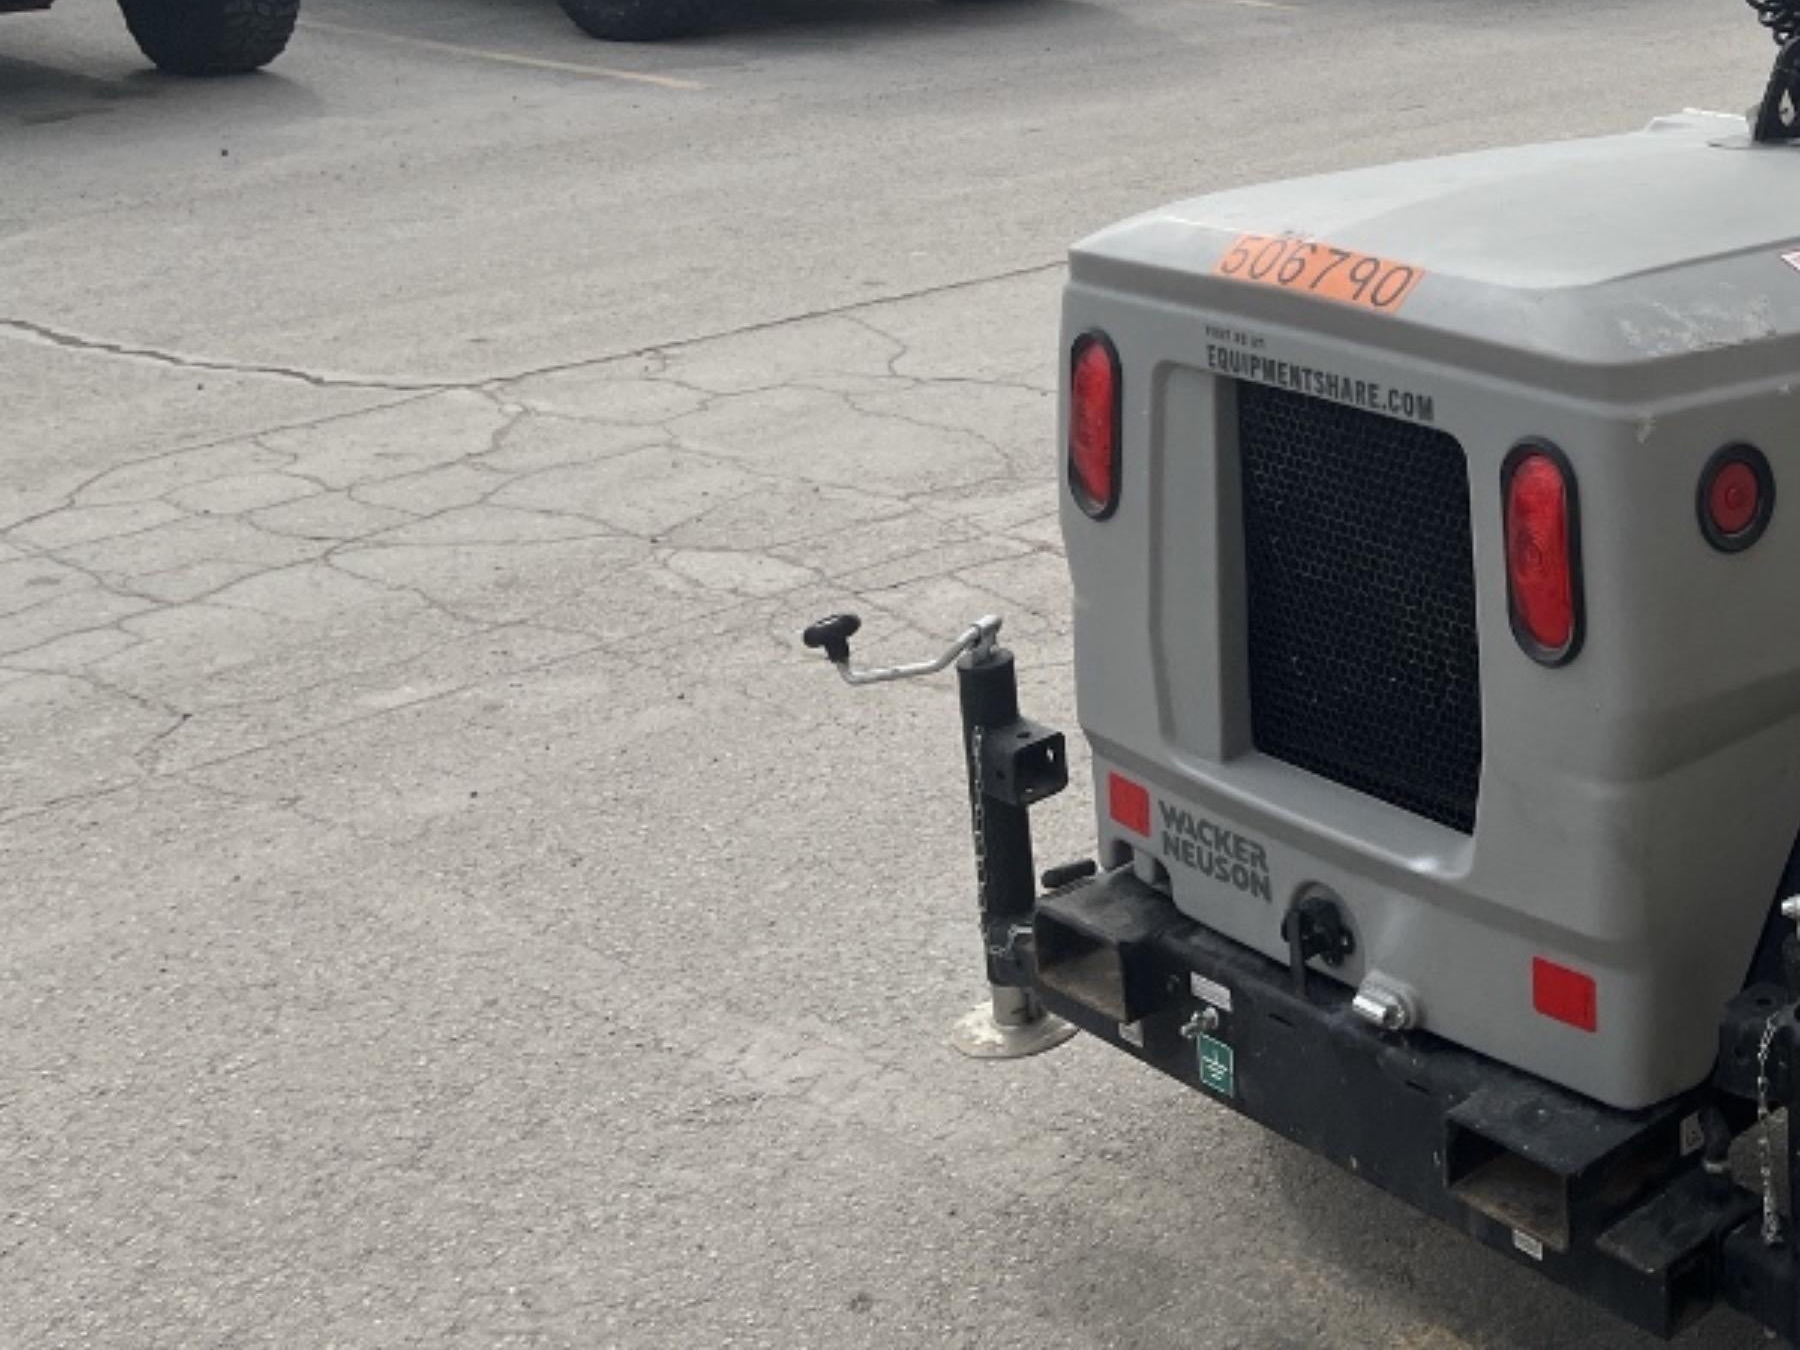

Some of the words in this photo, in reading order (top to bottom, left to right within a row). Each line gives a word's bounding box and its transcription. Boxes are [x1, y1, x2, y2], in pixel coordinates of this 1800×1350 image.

[1220, 236, 1414, 307] 506790
[1206, 344, 1434, 421] EQUIPMENTSHARE.COM
[1158, 799, 1270, 873] WACKER
[1163, 830, 1273, 904] NEUSON
